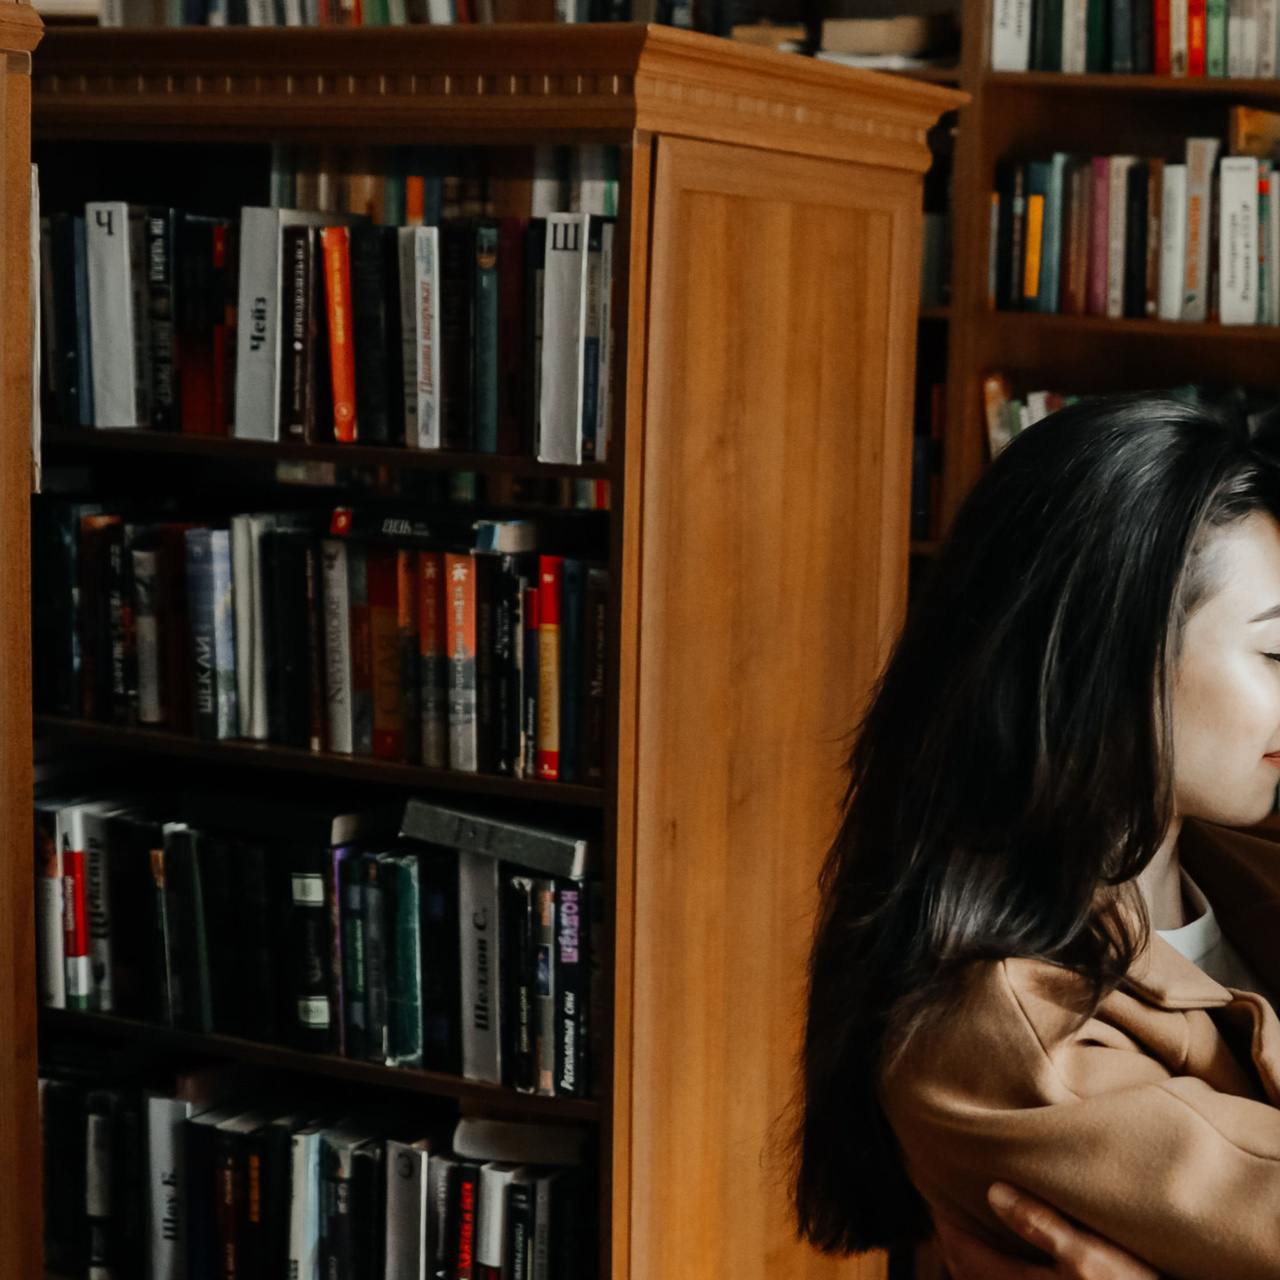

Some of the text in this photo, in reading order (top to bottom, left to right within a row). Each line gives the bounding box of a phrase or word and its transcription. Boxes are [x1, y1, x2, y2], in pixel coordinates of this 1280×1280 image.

[95, 209, 115, 236] Ч
[551, 222, 580, 252] Ш
[249, 295, 267, 352] Чейз
[194, 635, 213, 715] ШЕКЛИ
[327, 594, 343, 705] NEVERMORE
[87, 837, 108, 940] Шекспир
[560, 889, 580, 964] ШЕЛДОН
[471, 906, 489, 1032] Шелдон С.
[560, 990, 576, 1092] Расколотые сны
[396, 1152, 414, 1180] Э
